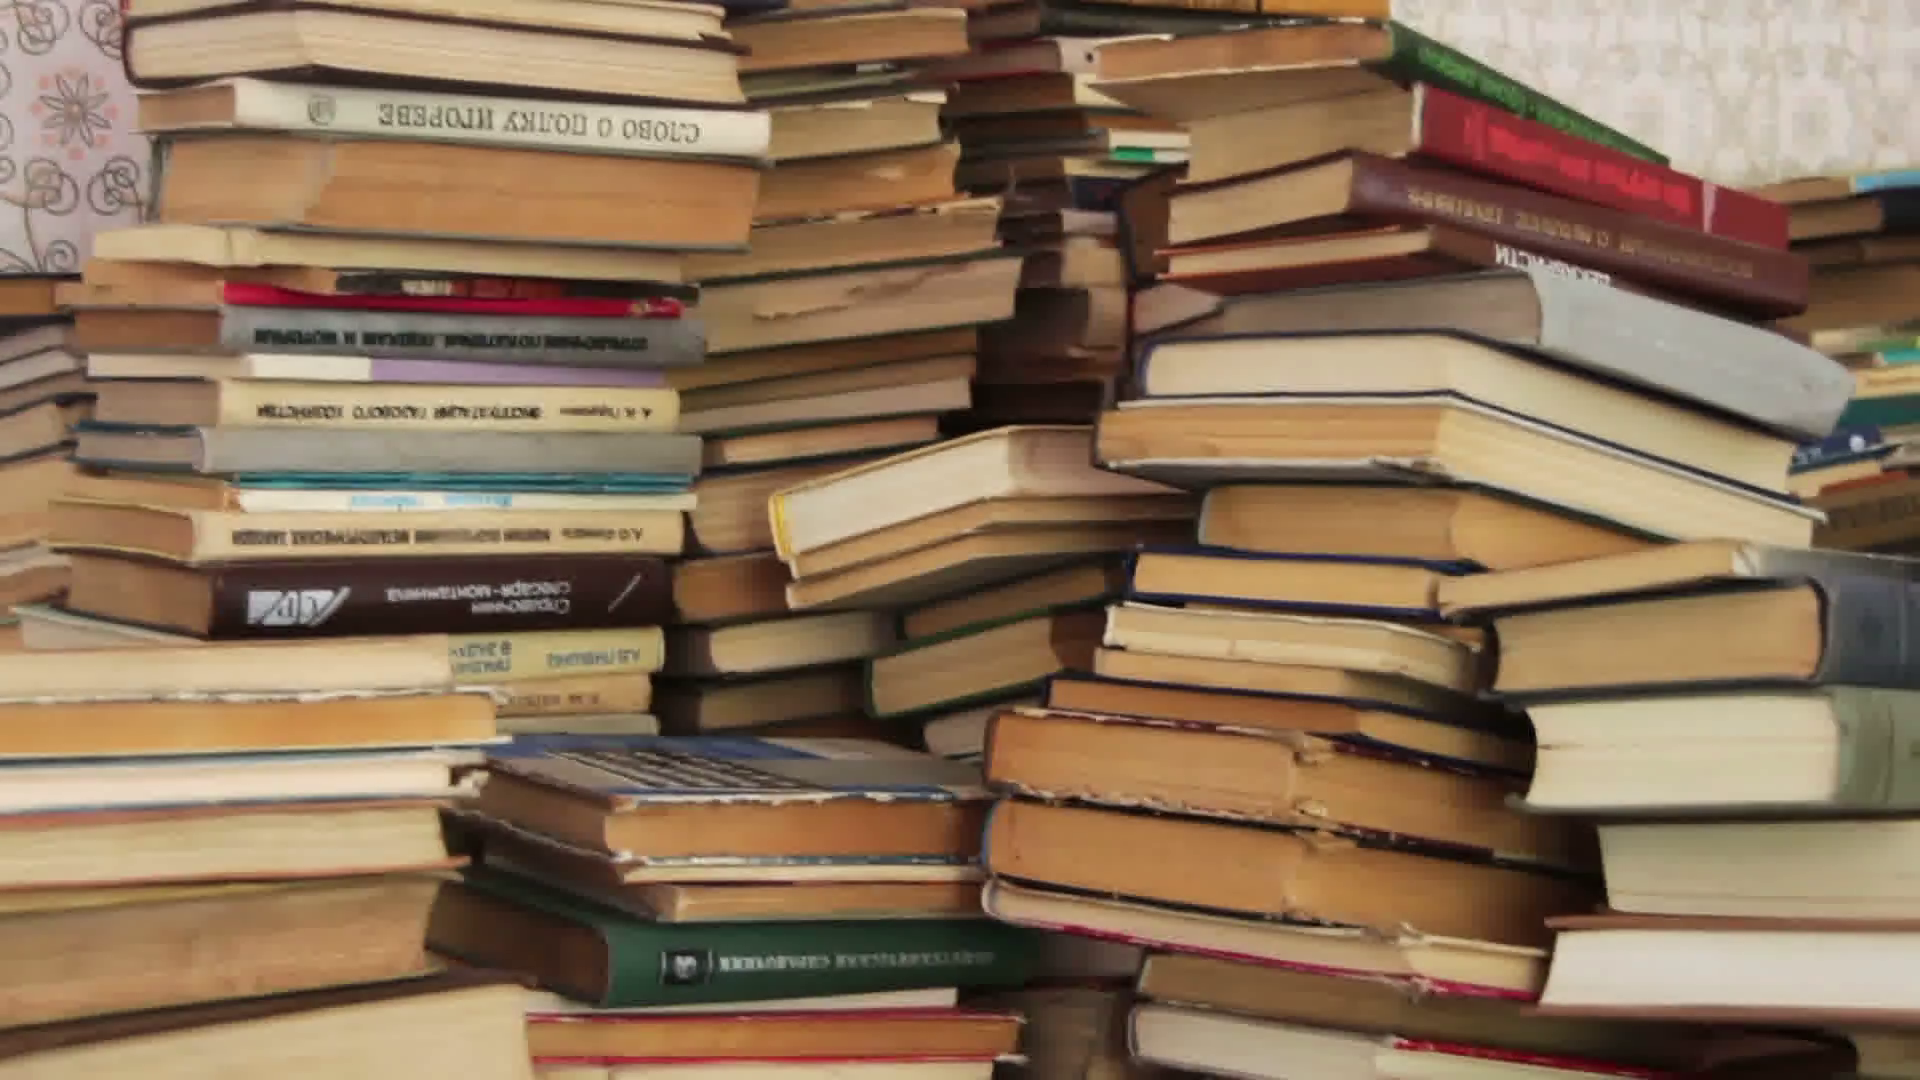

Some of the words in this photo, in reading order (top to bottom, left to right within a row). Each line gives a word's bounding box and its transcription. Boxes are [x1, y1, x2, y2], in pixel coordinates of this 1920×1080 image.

[377, 102, 494, 131] ИГОРЕВЕ
[503, 110, 588, 137] ПОЛКУ
[598, 118, 612, 139] О
[621, 117, 700, 145] СЛОВО
[352, 404, 427, 420] ГАЗОВОГО
